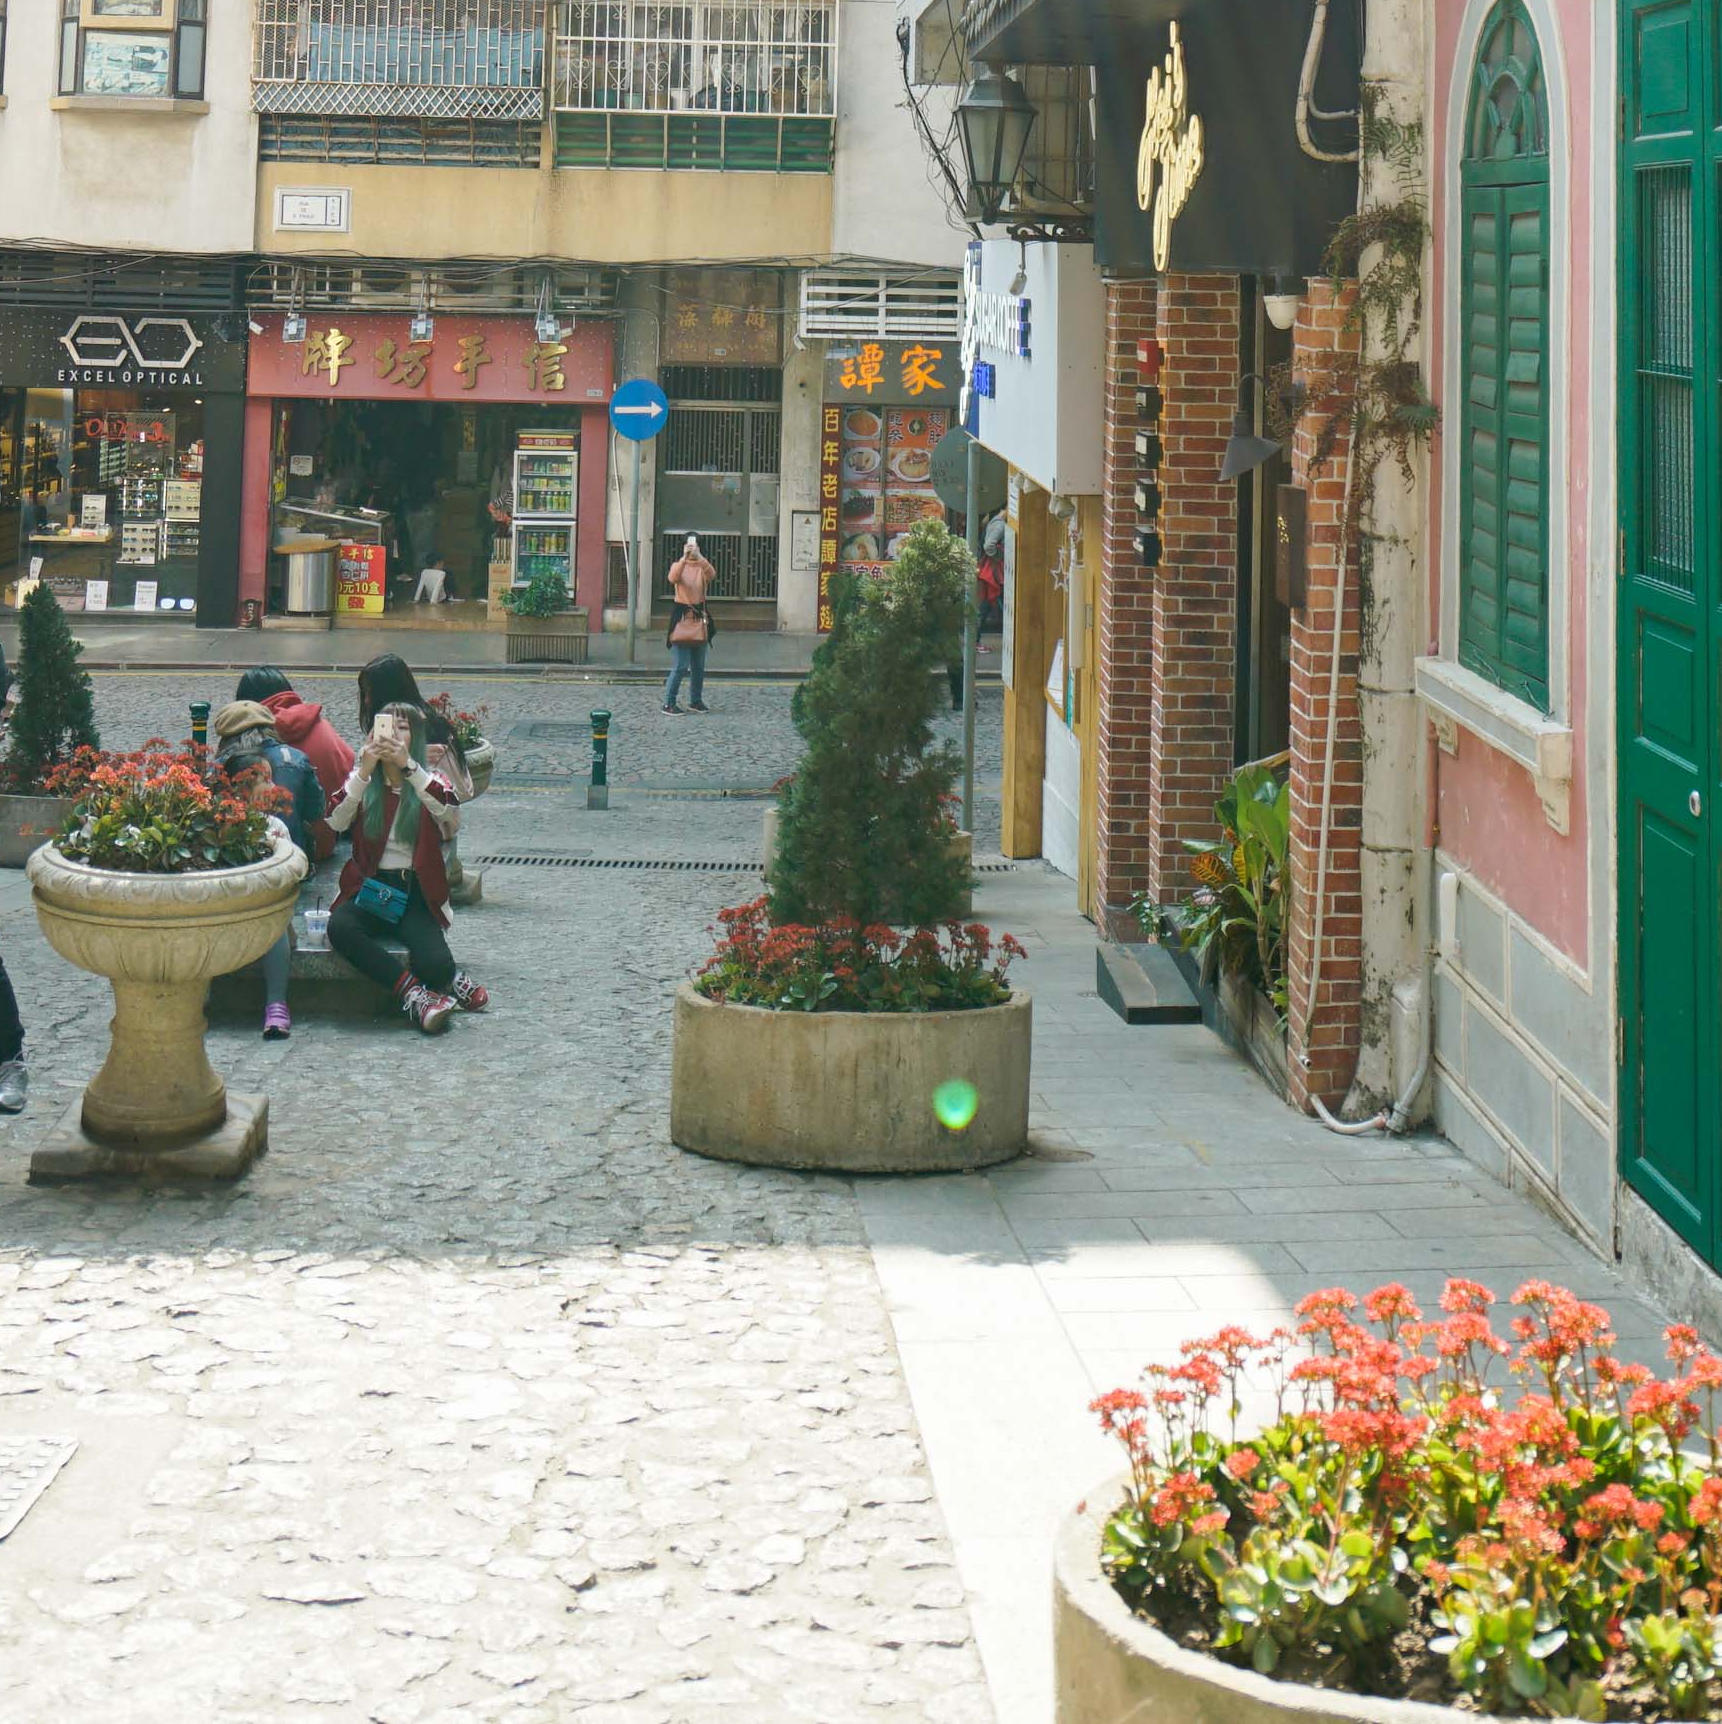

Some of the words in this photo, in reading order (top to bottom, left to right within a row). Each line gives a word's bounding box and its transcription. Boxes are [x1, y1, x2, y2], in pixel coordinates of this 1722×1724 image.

[57, 369, 116, 383] EXCEL
[122, 371, 203, 385] OPTICAL
[301, 327, 569, 391] 牌坊手信
[839, 343, 946, 396] 譚家
